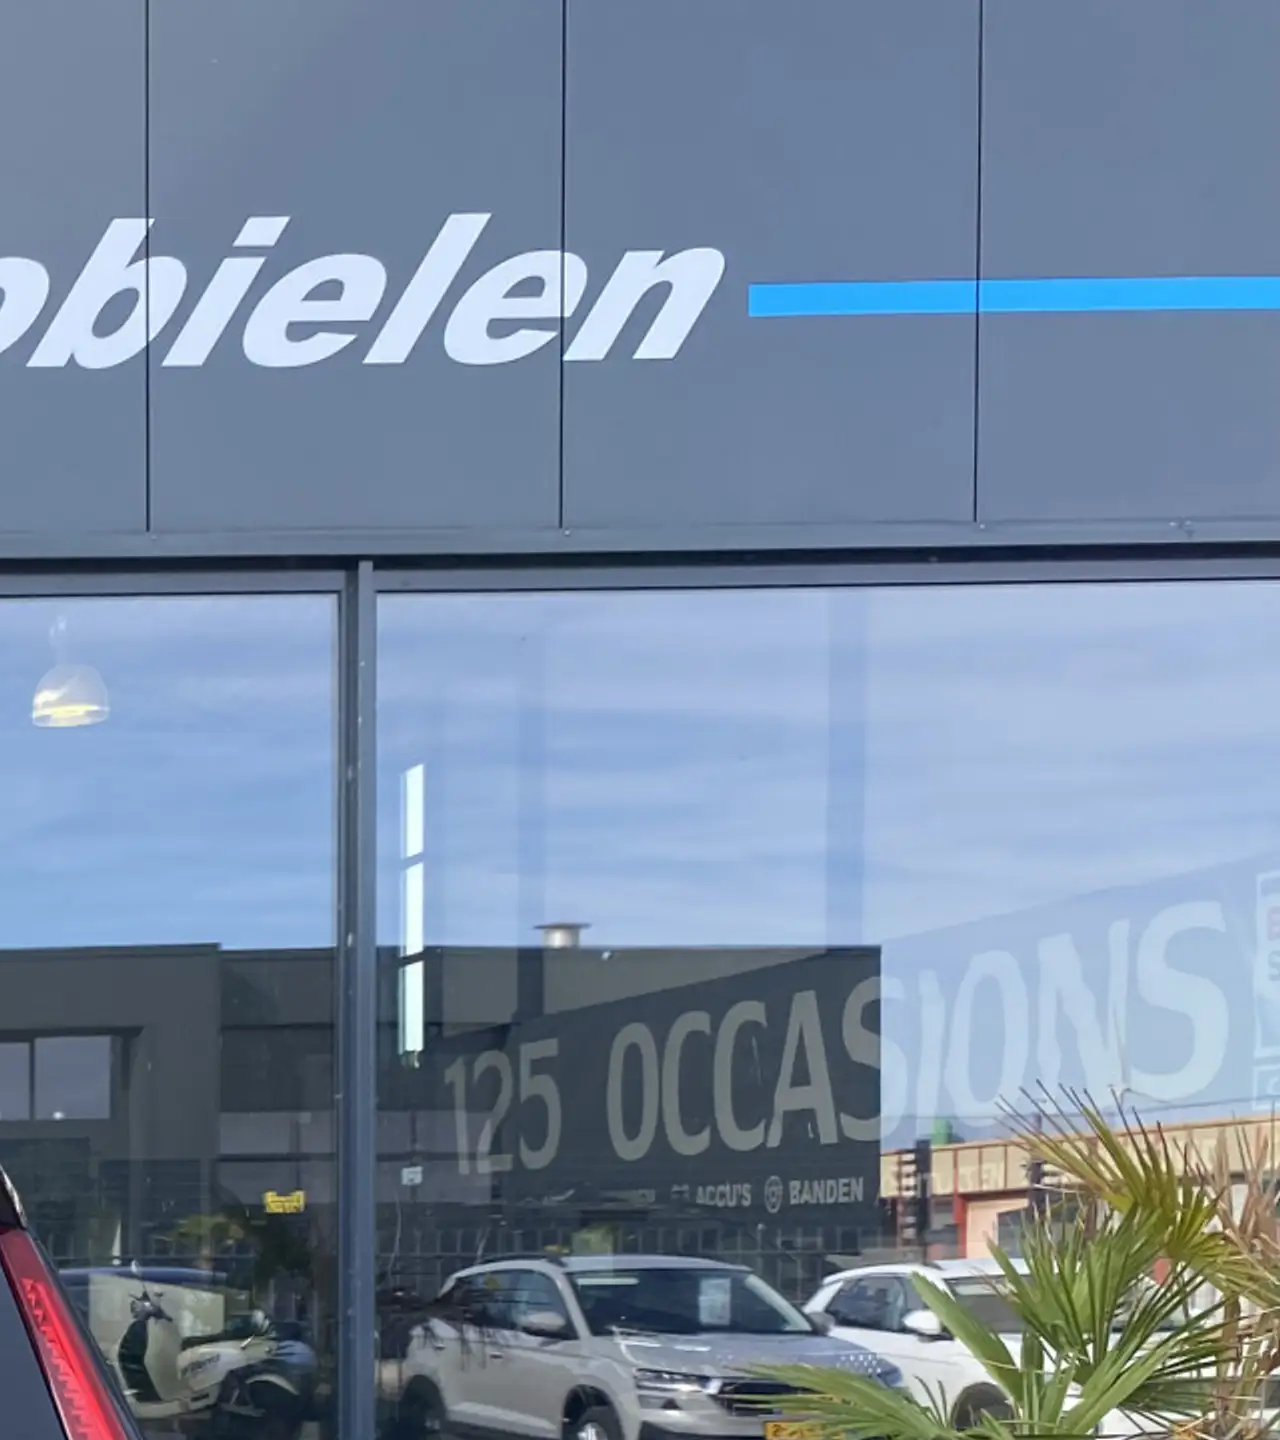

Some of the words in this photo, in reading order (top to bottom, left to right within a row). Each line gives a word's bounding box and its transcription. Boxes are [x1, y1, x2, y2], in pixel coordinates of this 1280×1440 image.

[444, 1038, 562, 1176] 125
[606, 900, 1228, 1161] OCCASIONS
[789, 1176, 864, 1206] BANDEN
